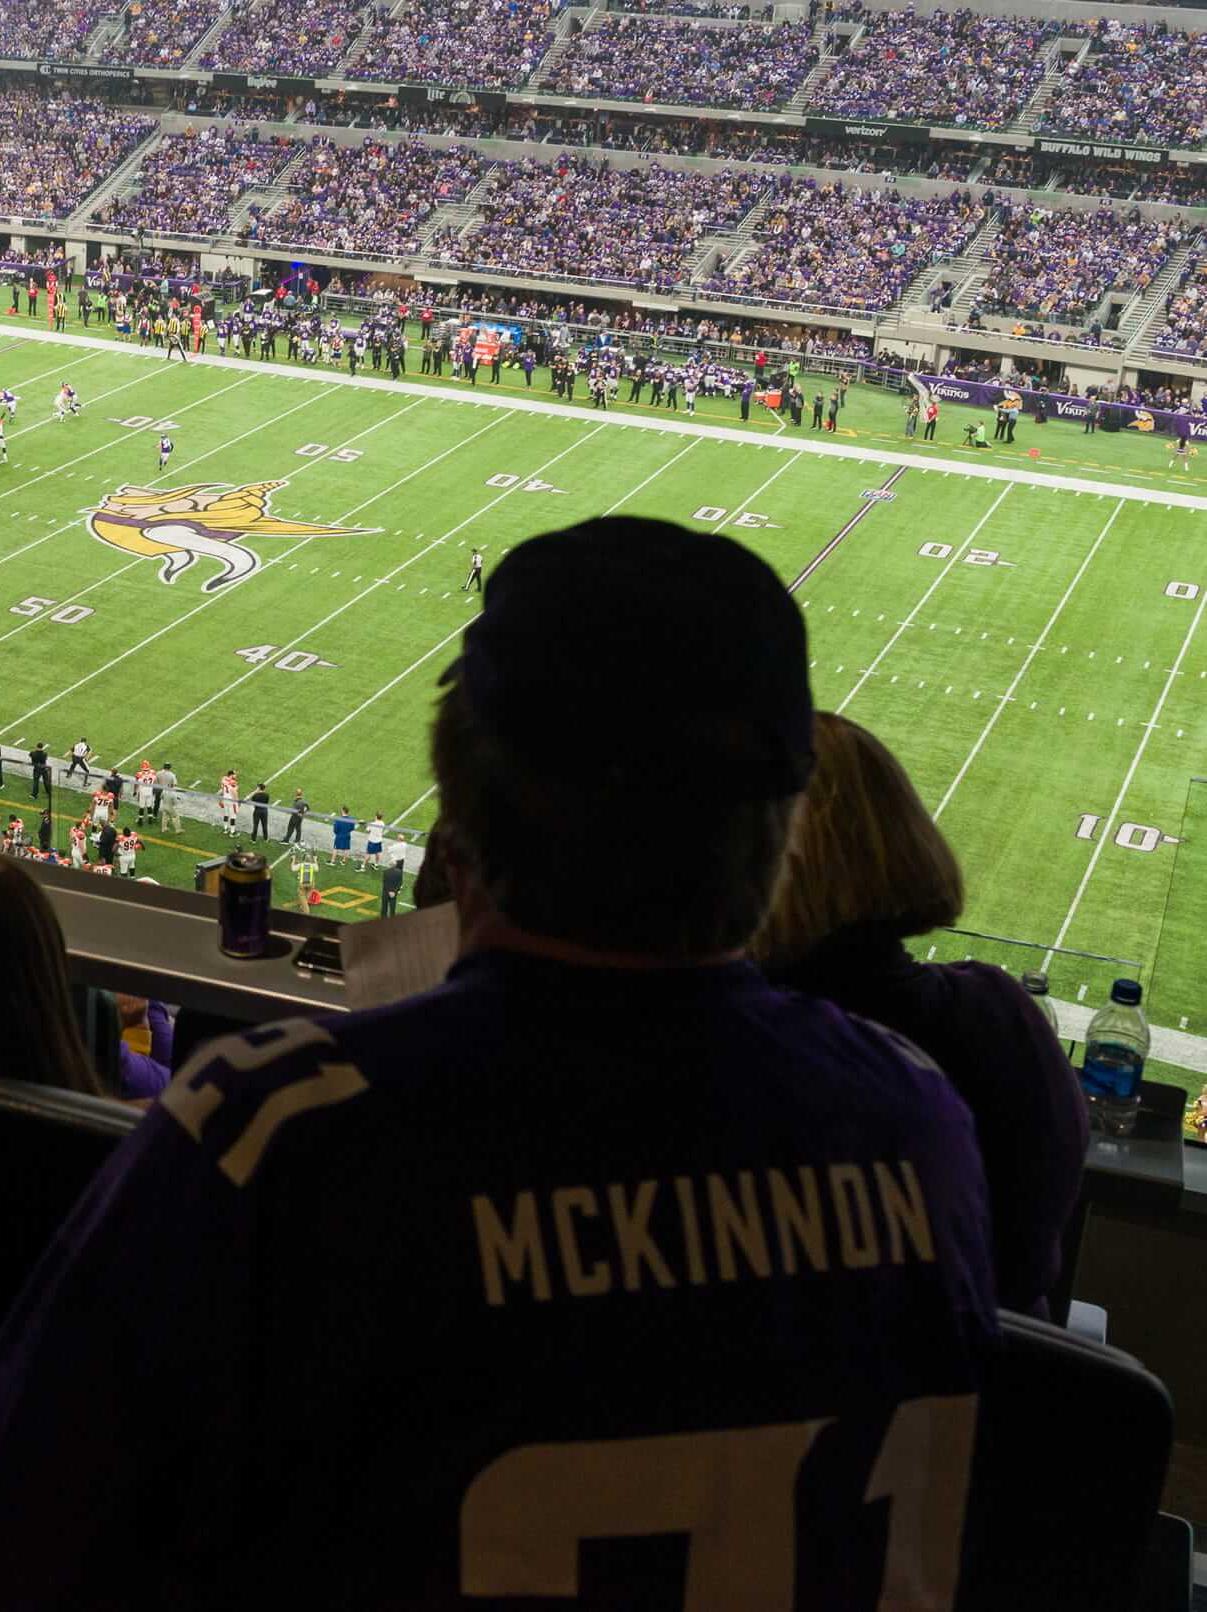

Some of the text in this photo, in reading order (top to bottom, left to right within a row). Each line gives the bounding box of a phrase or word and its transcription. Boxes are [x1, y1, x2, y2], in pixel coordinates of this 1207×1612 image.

[1041, 141, 1162, 163] BUFFALO WILD WINGS
[8, 595, 95, 625] 50
[233, 644, 321, 673] 40
[1075, 813, 1161, 852] 10
[472, 1160, 937, 1306] MCKINNON
